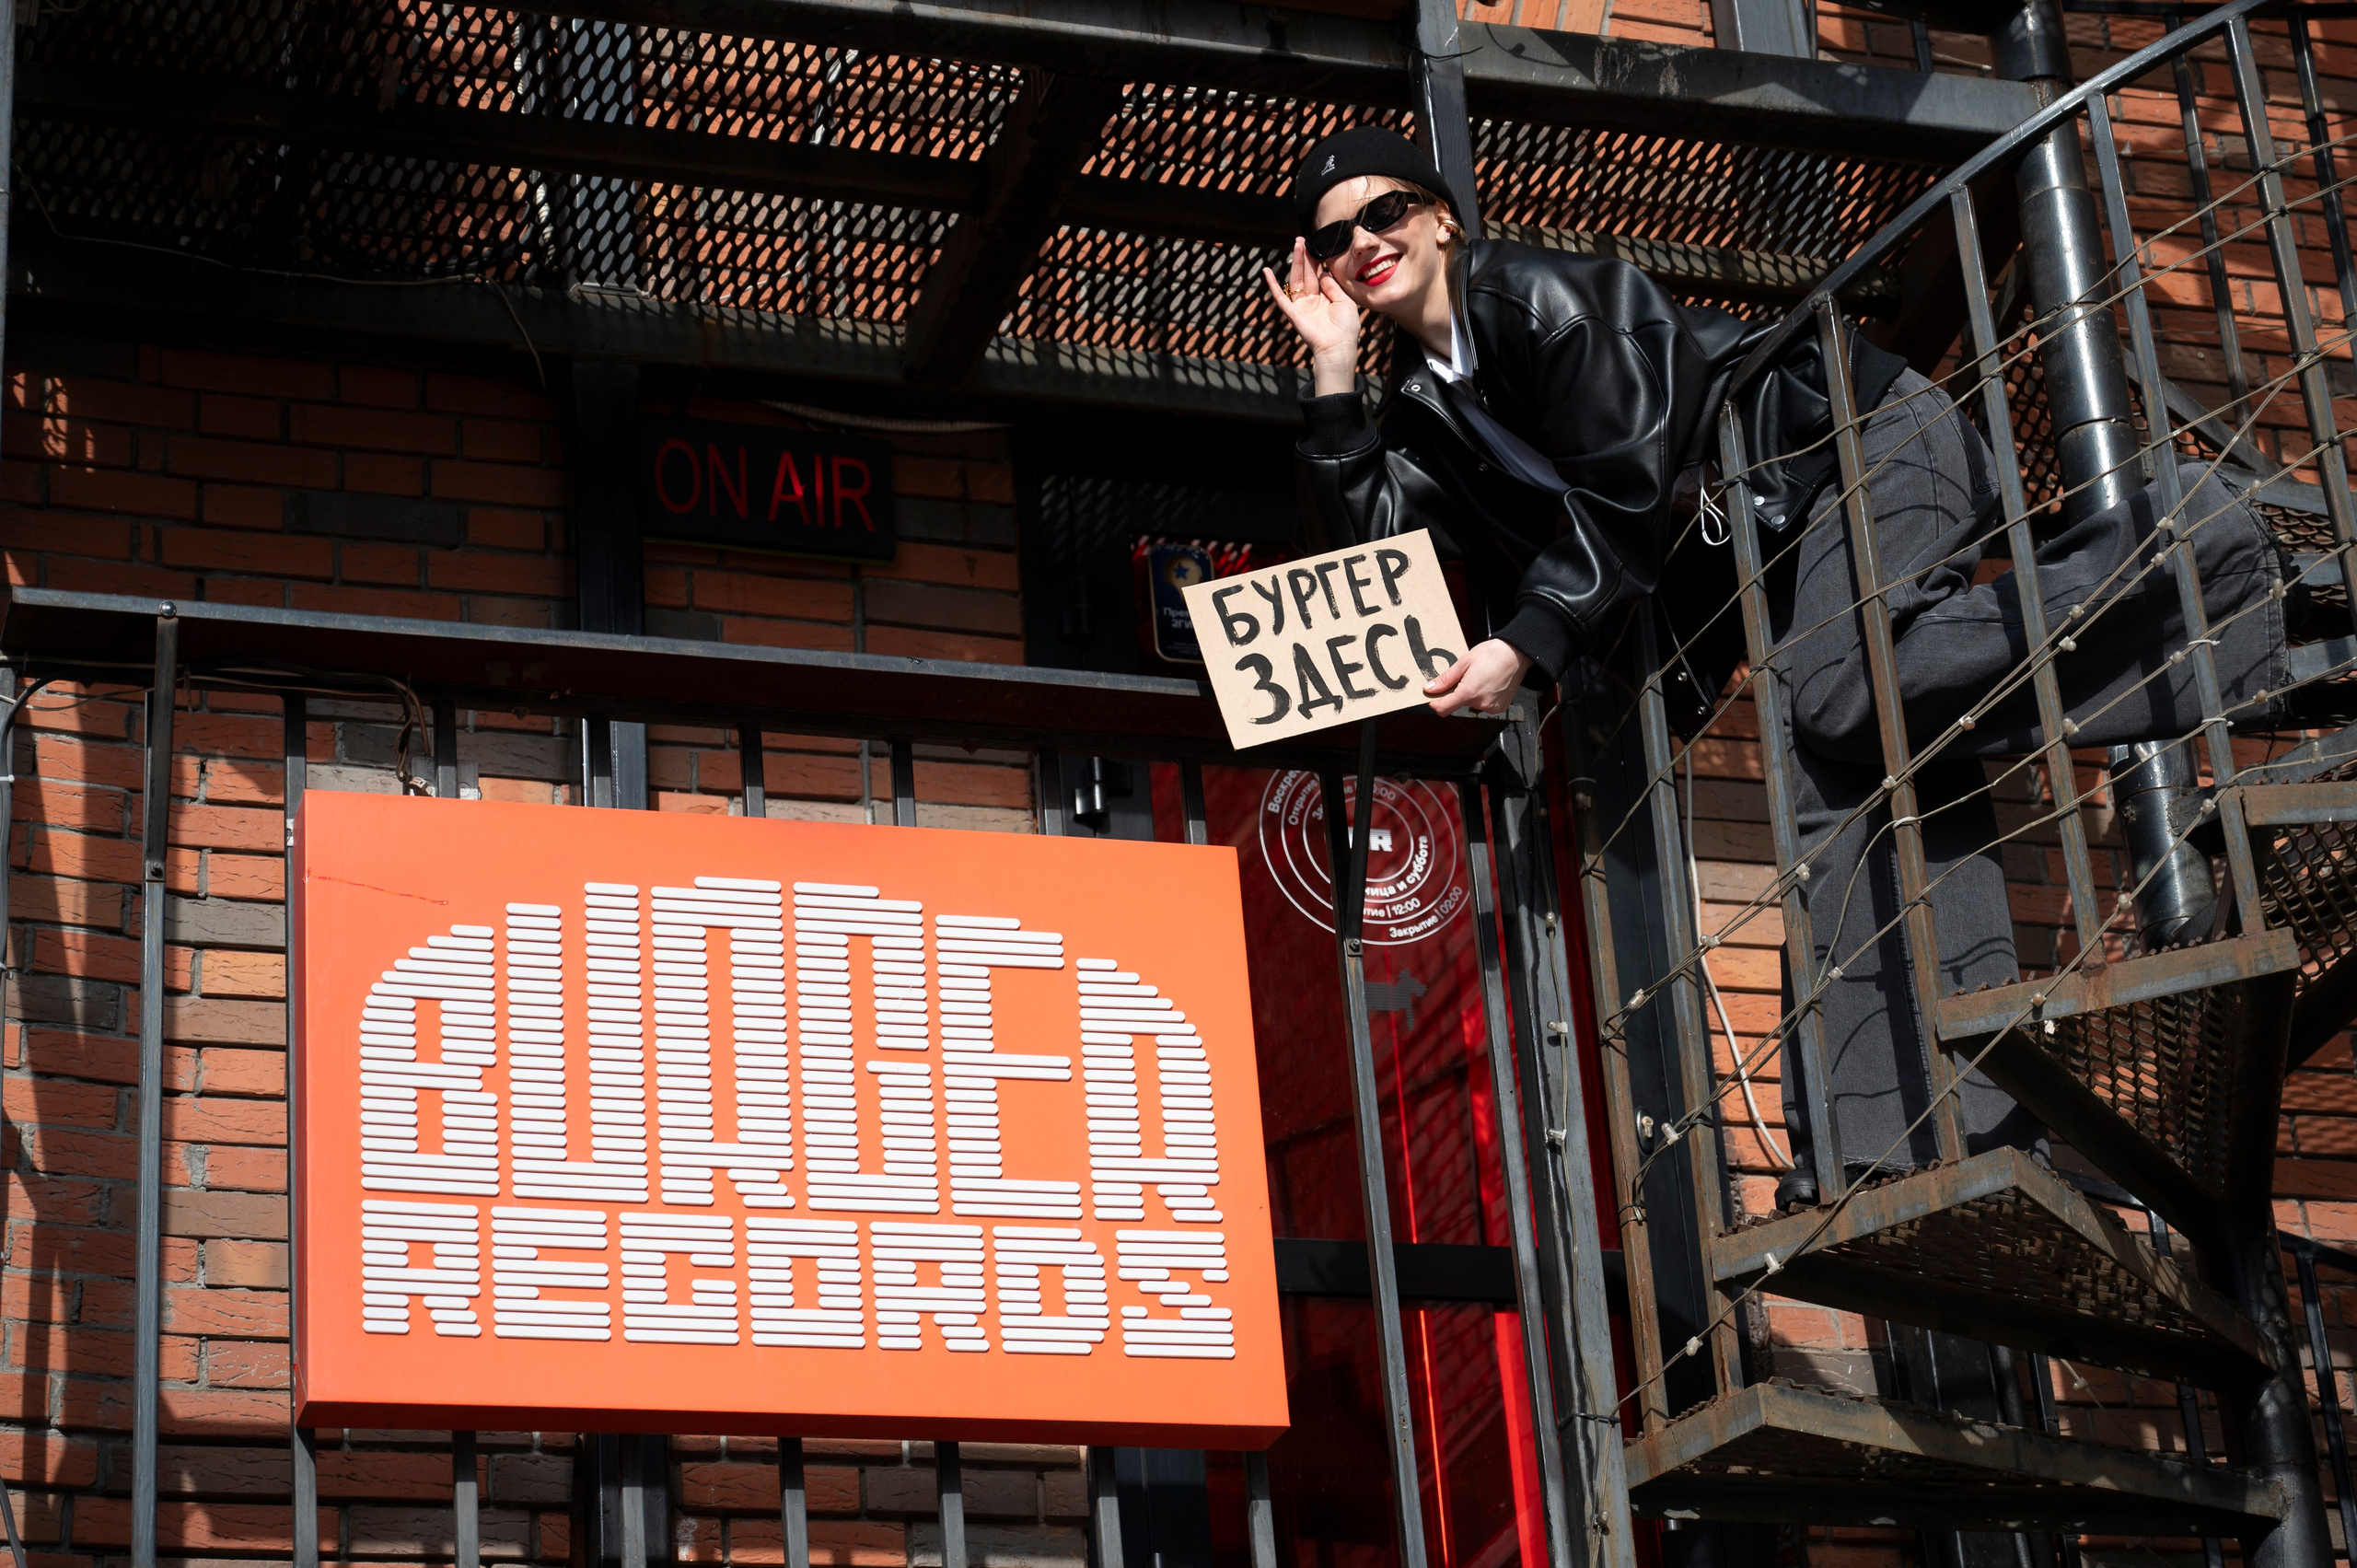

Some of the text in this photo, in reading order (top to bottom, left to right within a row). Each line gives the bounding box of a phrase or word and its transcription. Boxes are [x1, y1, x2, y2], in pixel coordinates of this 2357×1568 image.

[655, 437, 877, 532] ON AIR
[1212, 548, 1411, 647] БУРГЕР
[1235, 614, 1458, 725] ЗДЕСЬ
[1288, 779, 1318, 826] Открытие
[1391, 898, 1421, 915] 12:00
[1396, 880, 1408, 891] и
[1406, 835, 1428, 884] суббота
[1389, 886, 1463, 938] Закрытие 02:00
[359, 876, 1223, 1222] BURGER
[361, 1199, 1236, 1360] RECORDS
